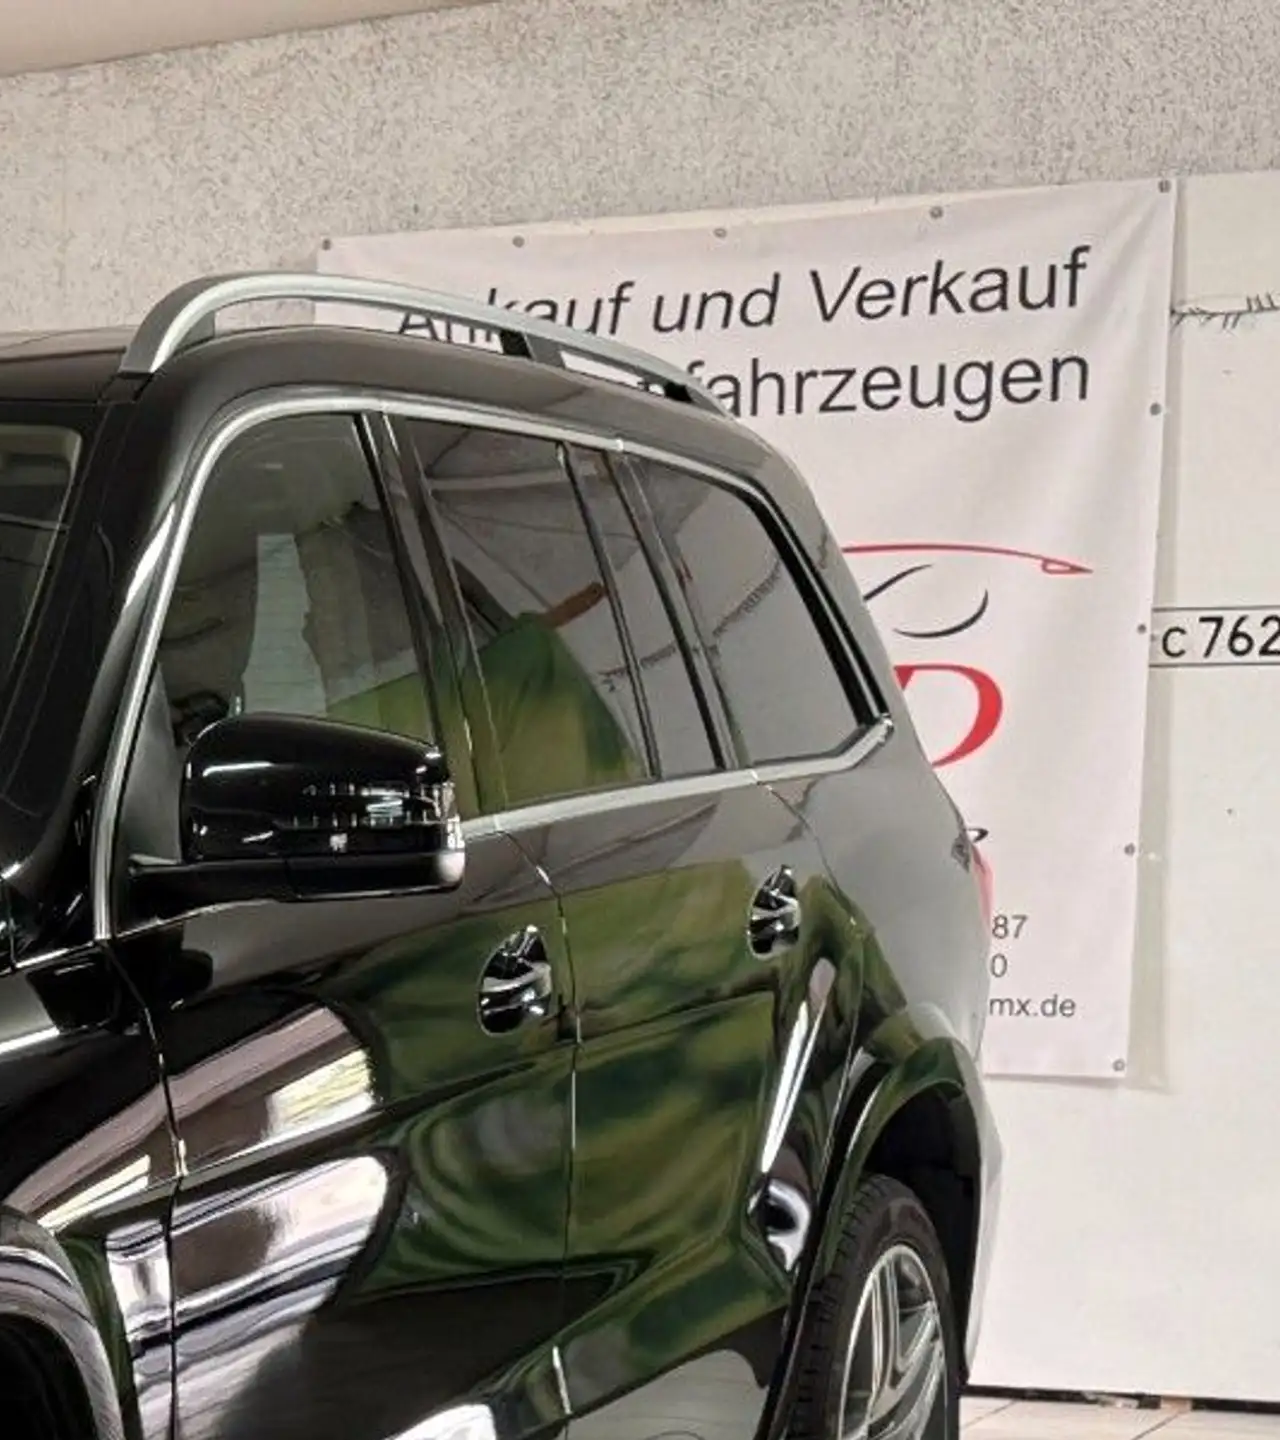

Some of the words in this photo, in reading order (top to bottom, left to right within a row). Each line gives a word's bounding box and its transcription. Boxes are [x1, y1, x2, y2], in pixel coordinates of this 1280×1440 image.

[652, 272, 780, 333] und
[809, 244, 1092, 323] Verkauf
[687, 353, 1090, 423] ahrzeugen
